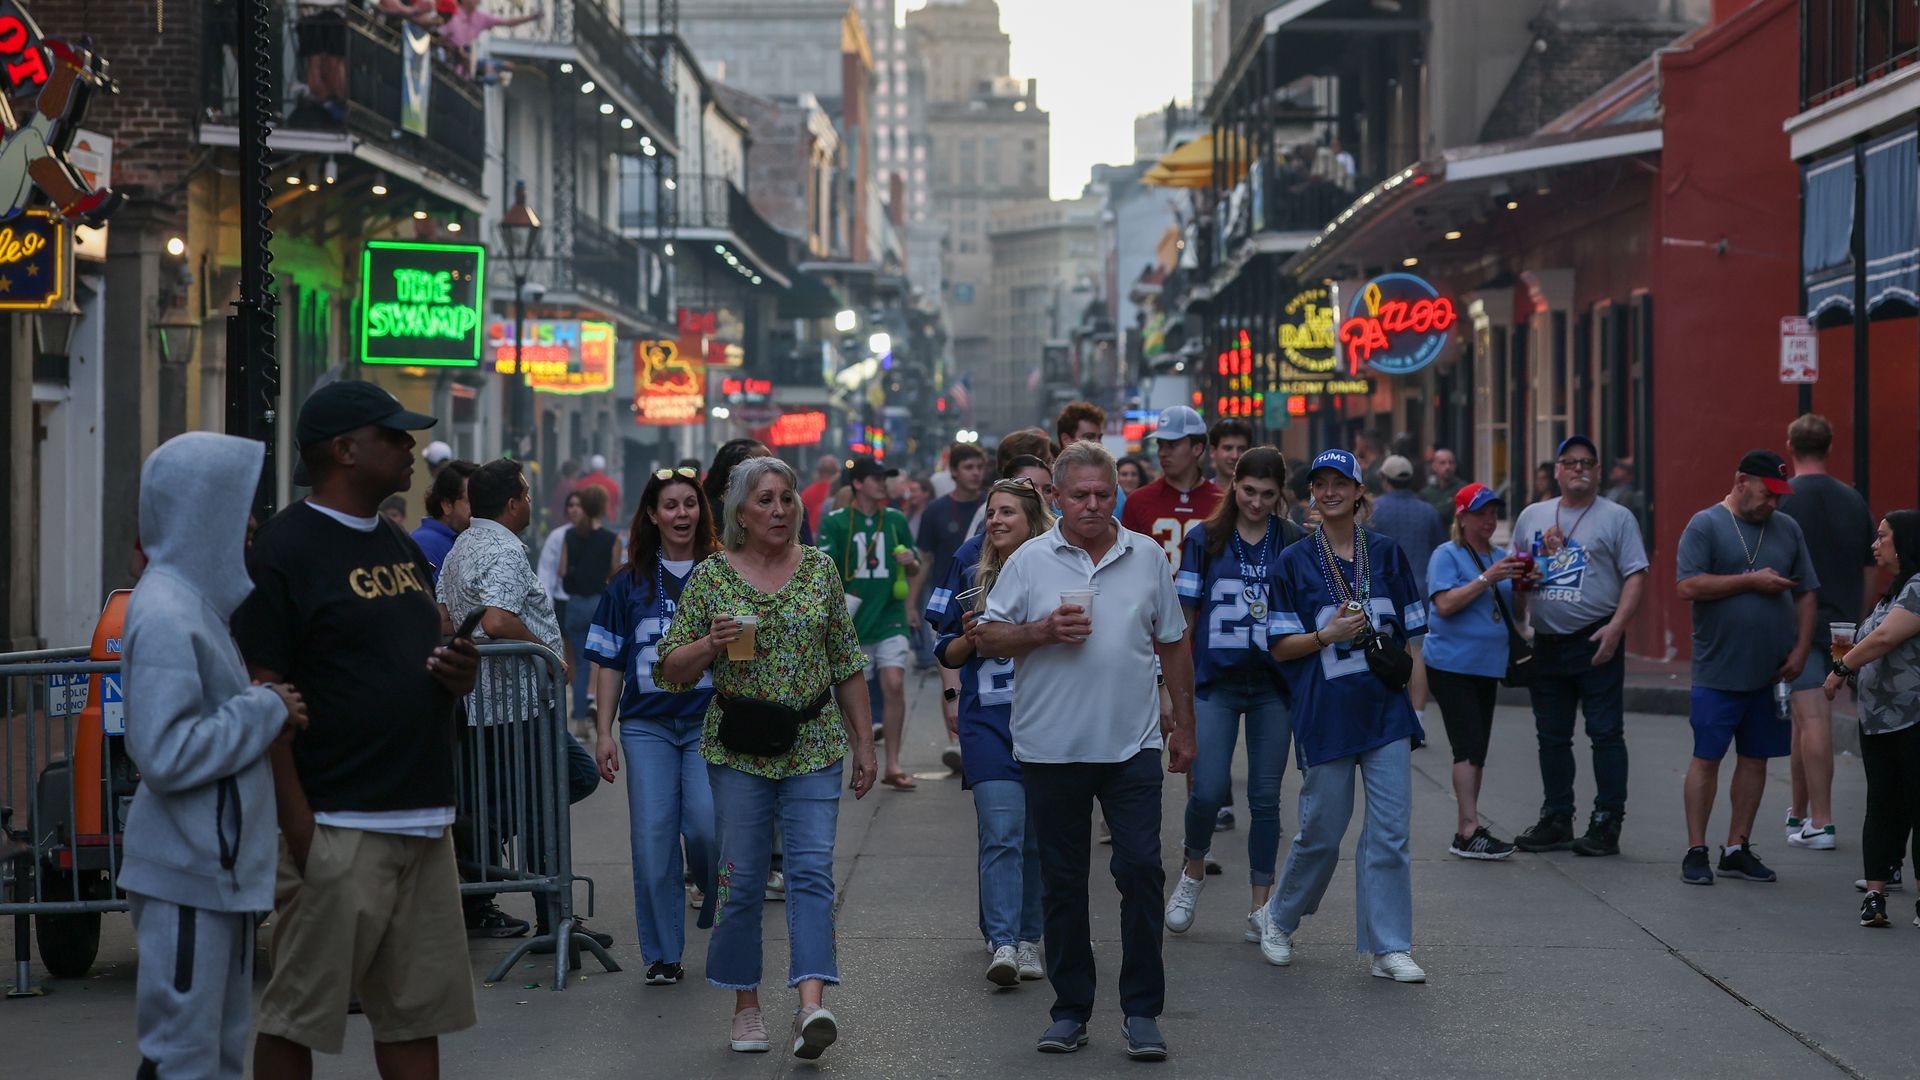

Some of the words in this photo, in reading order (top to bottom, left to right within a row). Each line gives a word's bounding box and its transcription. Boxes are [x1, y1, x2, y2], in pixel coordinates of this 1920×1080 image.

[393, 269, 452, 303] THE
[368, 302, 476, 341] SWAMP
[1319, 452, 1347, 463] TUMS
[853, 531, 889, 579] 11
[349, 562, 423, 599] GOAT
